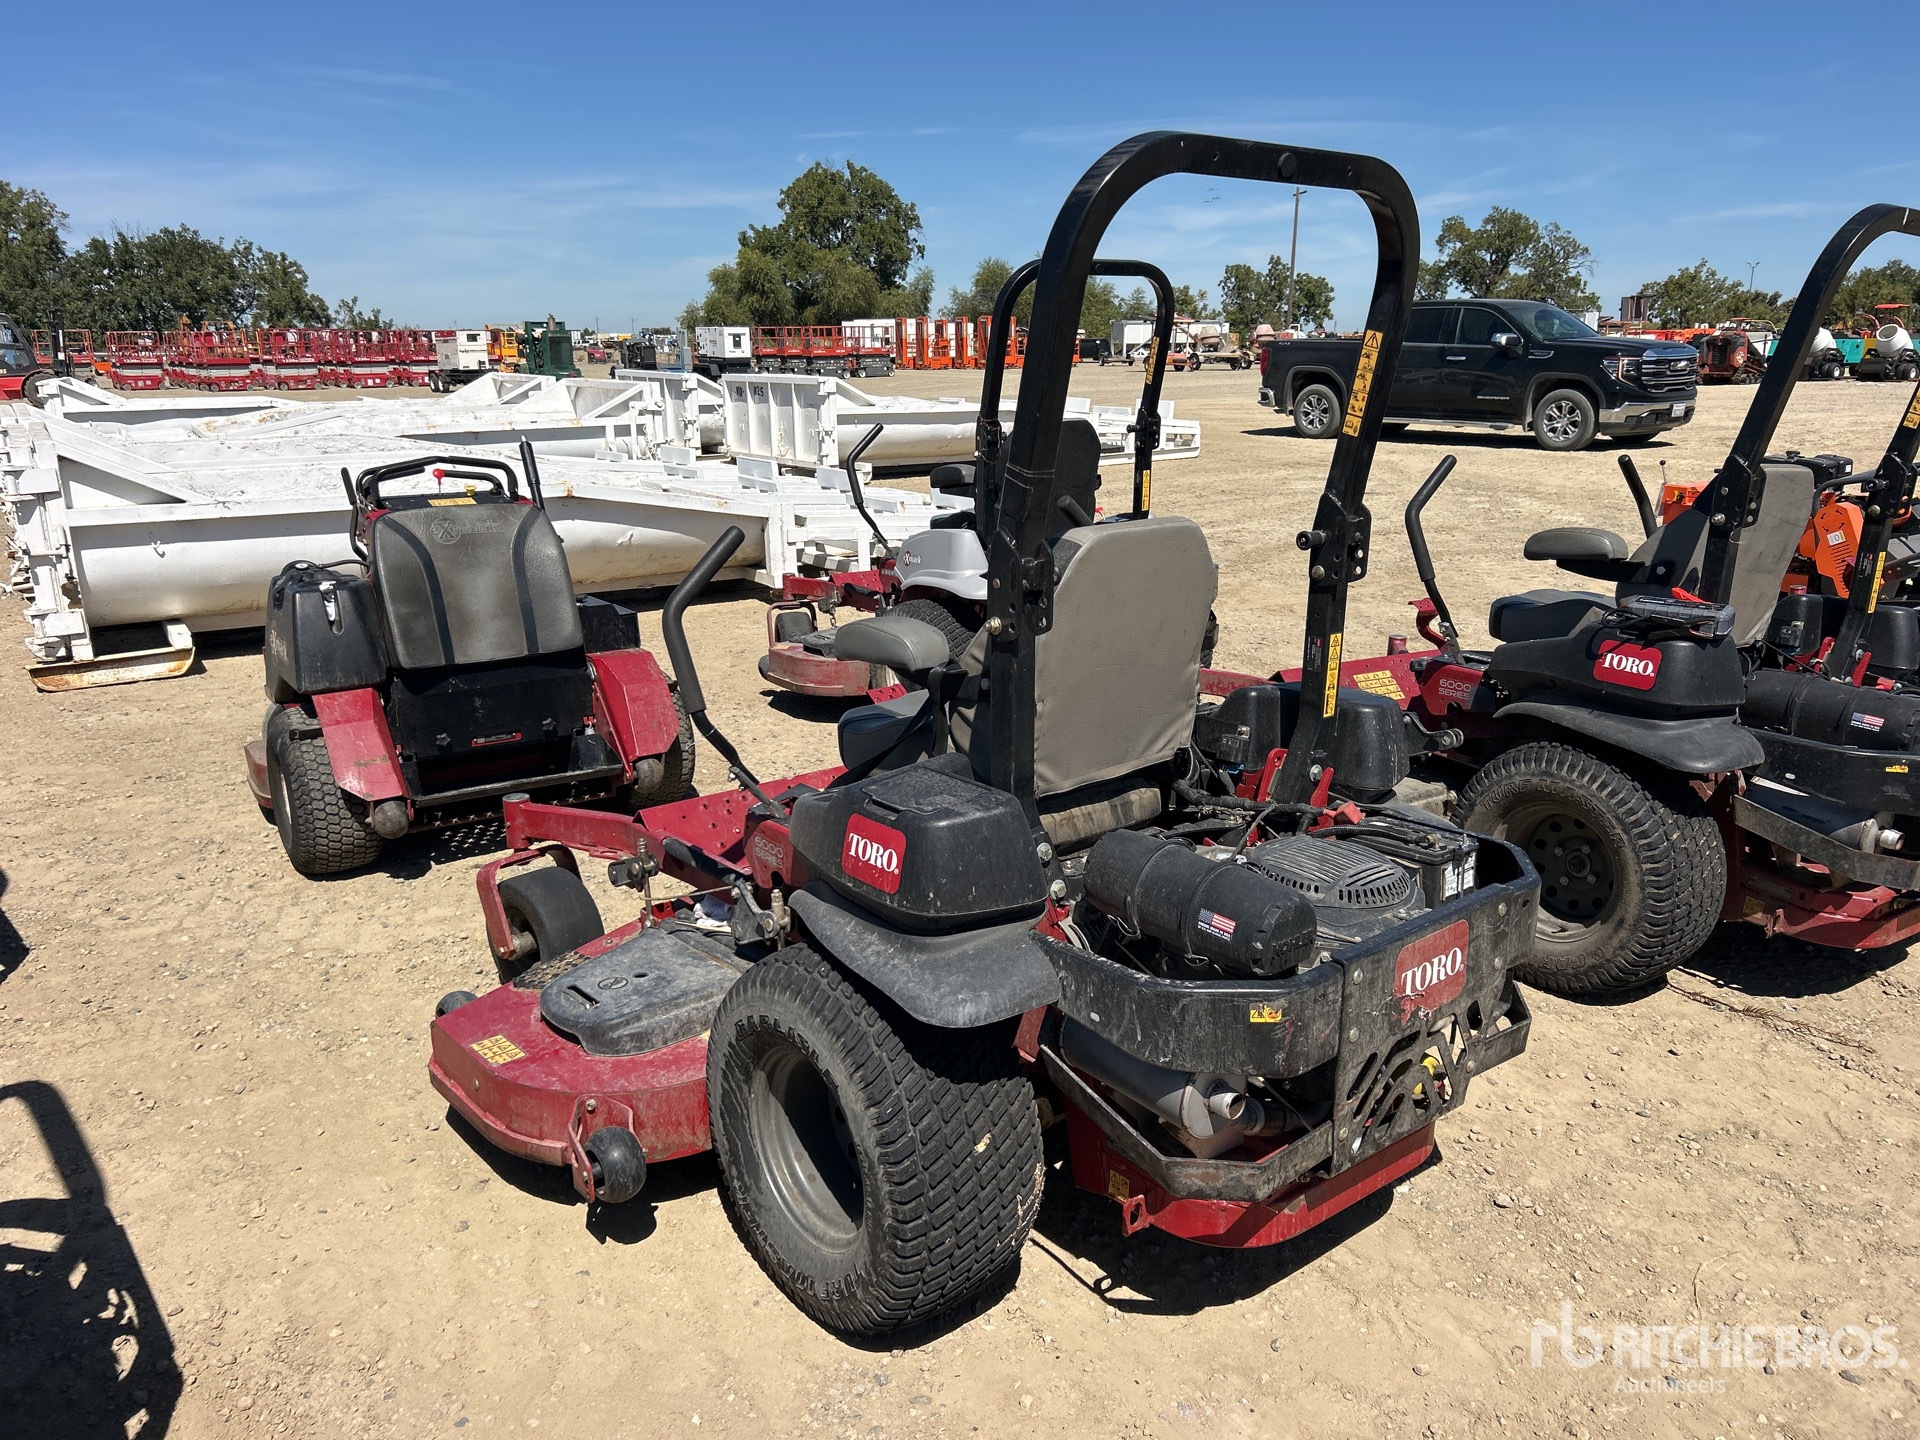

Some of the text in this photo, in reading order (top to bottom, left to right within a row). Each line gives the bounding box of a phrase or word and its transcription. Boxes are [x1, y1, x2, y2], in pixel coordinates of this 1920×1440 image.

[1602, 652, 1655, 677] TORO
[1438, 688, 1470, 700] SERIES
[1440, 678, 1472, 692] 6000
[1480, 778, 1626, 849] TURF MASTER
[755, 836, 784, 858] 6000
[755, 848, 784, 869] SERIES
[849, 832, 898, 873] TORO
[1401, 947, 1462, 996] TORO
